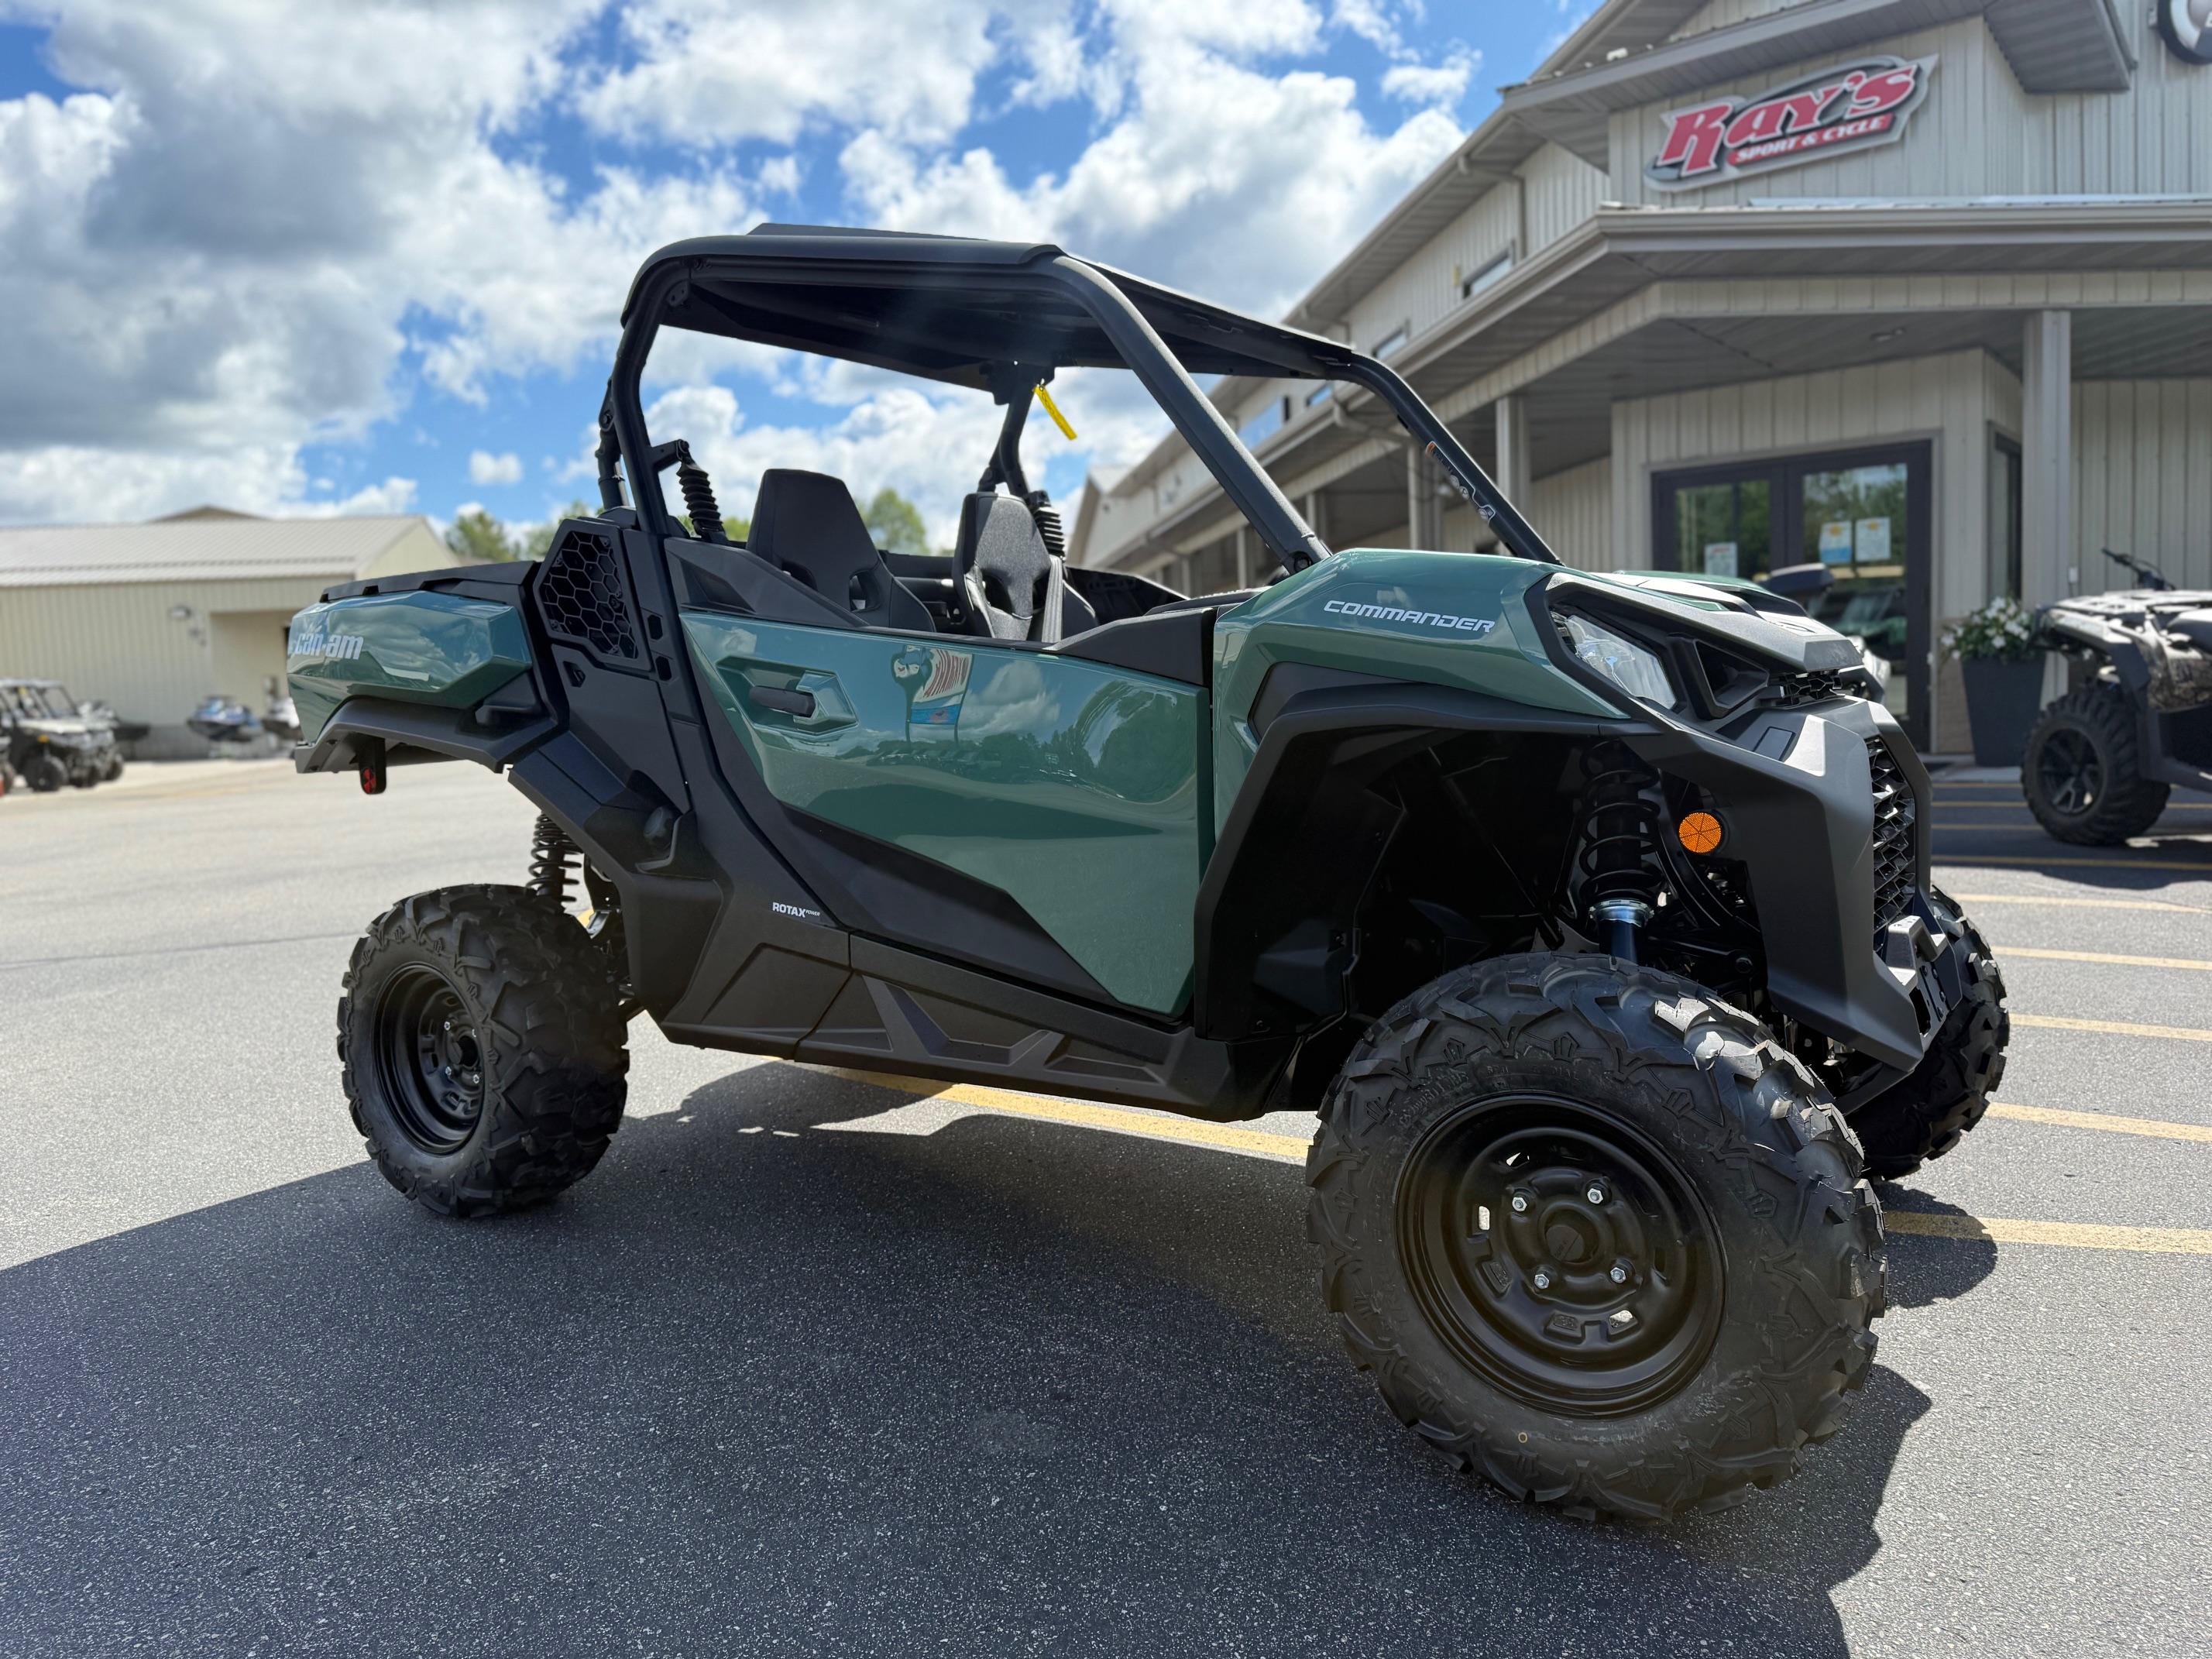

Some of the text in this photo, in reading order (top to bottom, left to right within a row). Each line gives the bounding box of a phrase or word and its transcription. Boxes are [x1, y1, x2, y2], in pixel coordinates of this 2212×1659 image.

[1736, 116, 1885, 162] SPORT & CYCLE
[1324, 600, 1496, 633] COMMANDER
[772, 902, 805, 918] ROTAX
